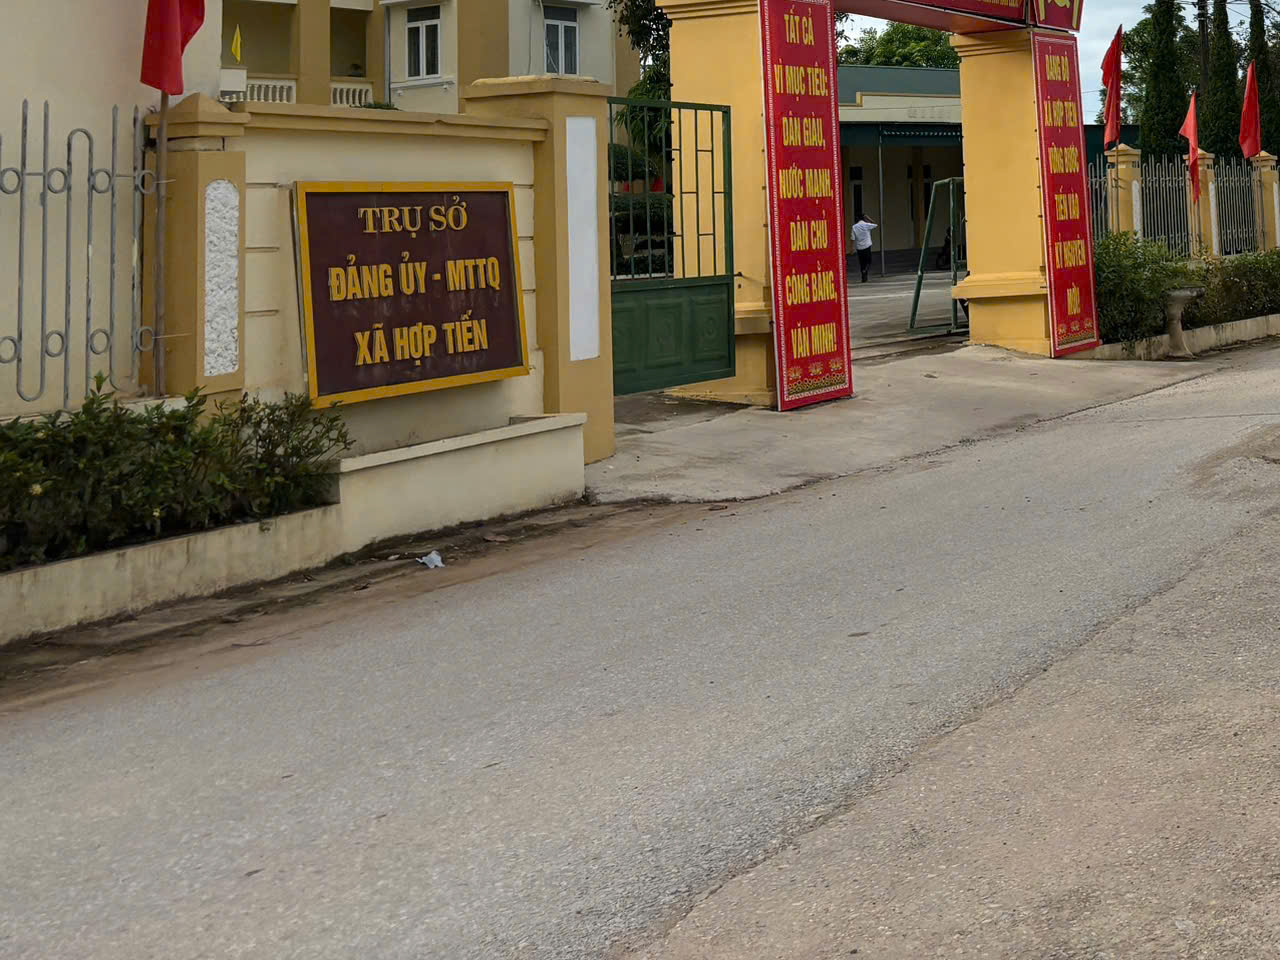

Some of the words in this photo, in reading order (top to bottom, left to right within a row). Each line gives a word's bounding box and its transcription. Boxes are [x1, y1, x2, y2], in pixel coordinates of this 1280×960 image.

[784, 4, 800, 43] TẤT
[802, 7, 814, 46] CẢ
[774, 58, 784, 94] VÌ
[785, 65, 805, 102] MỤC
[807, 61, 828, 97] TIÊU:
[1045, 46, 1062, 81] ĐẢNG
[1061, 50, 1070, 88] BỘ
[782, 110, 801, 147] DÂN
[803, 111, 826, 151] GIÀU,
[1043, 95, 1053, 127] XÃ
[1053, 98, 1064, 133] HỢP
[1064, 94, 1078, 128] TIẾN
[779, 162, 804, 199] NƯỚC
[806, 168, 834, 205] MẠNH,
[1055, 185, 1068, 221] TIẾN
[1067, 186, 1080, 220] VÀO
[358, 206, 423, 238] TRỤ
[429, 195, 468, 231] SỞ
[790, 214, 809, 251] DÂN
[811, 209, 828, 250] CHỦ
[1063, 233, 1086, 268] NGUYÊN
[328, 254, 394, 302] ĐẢNG
[398, 251, 427, 295] ỦY
[432, 272, 441, 280] -
[446, 256, 501, 292] MTTQ
[785, 268, 810, 306] CÔNG
[812, 260, 838, 303] BẰNG,
[354, 322, 390, 366] XÃ
[392, 321, 437, 366] HỢP
[442, 309, 488, 354] TIẾN
[791, 321, 810, 360] VĂN
[811, 322, 837, 357] MINH!
